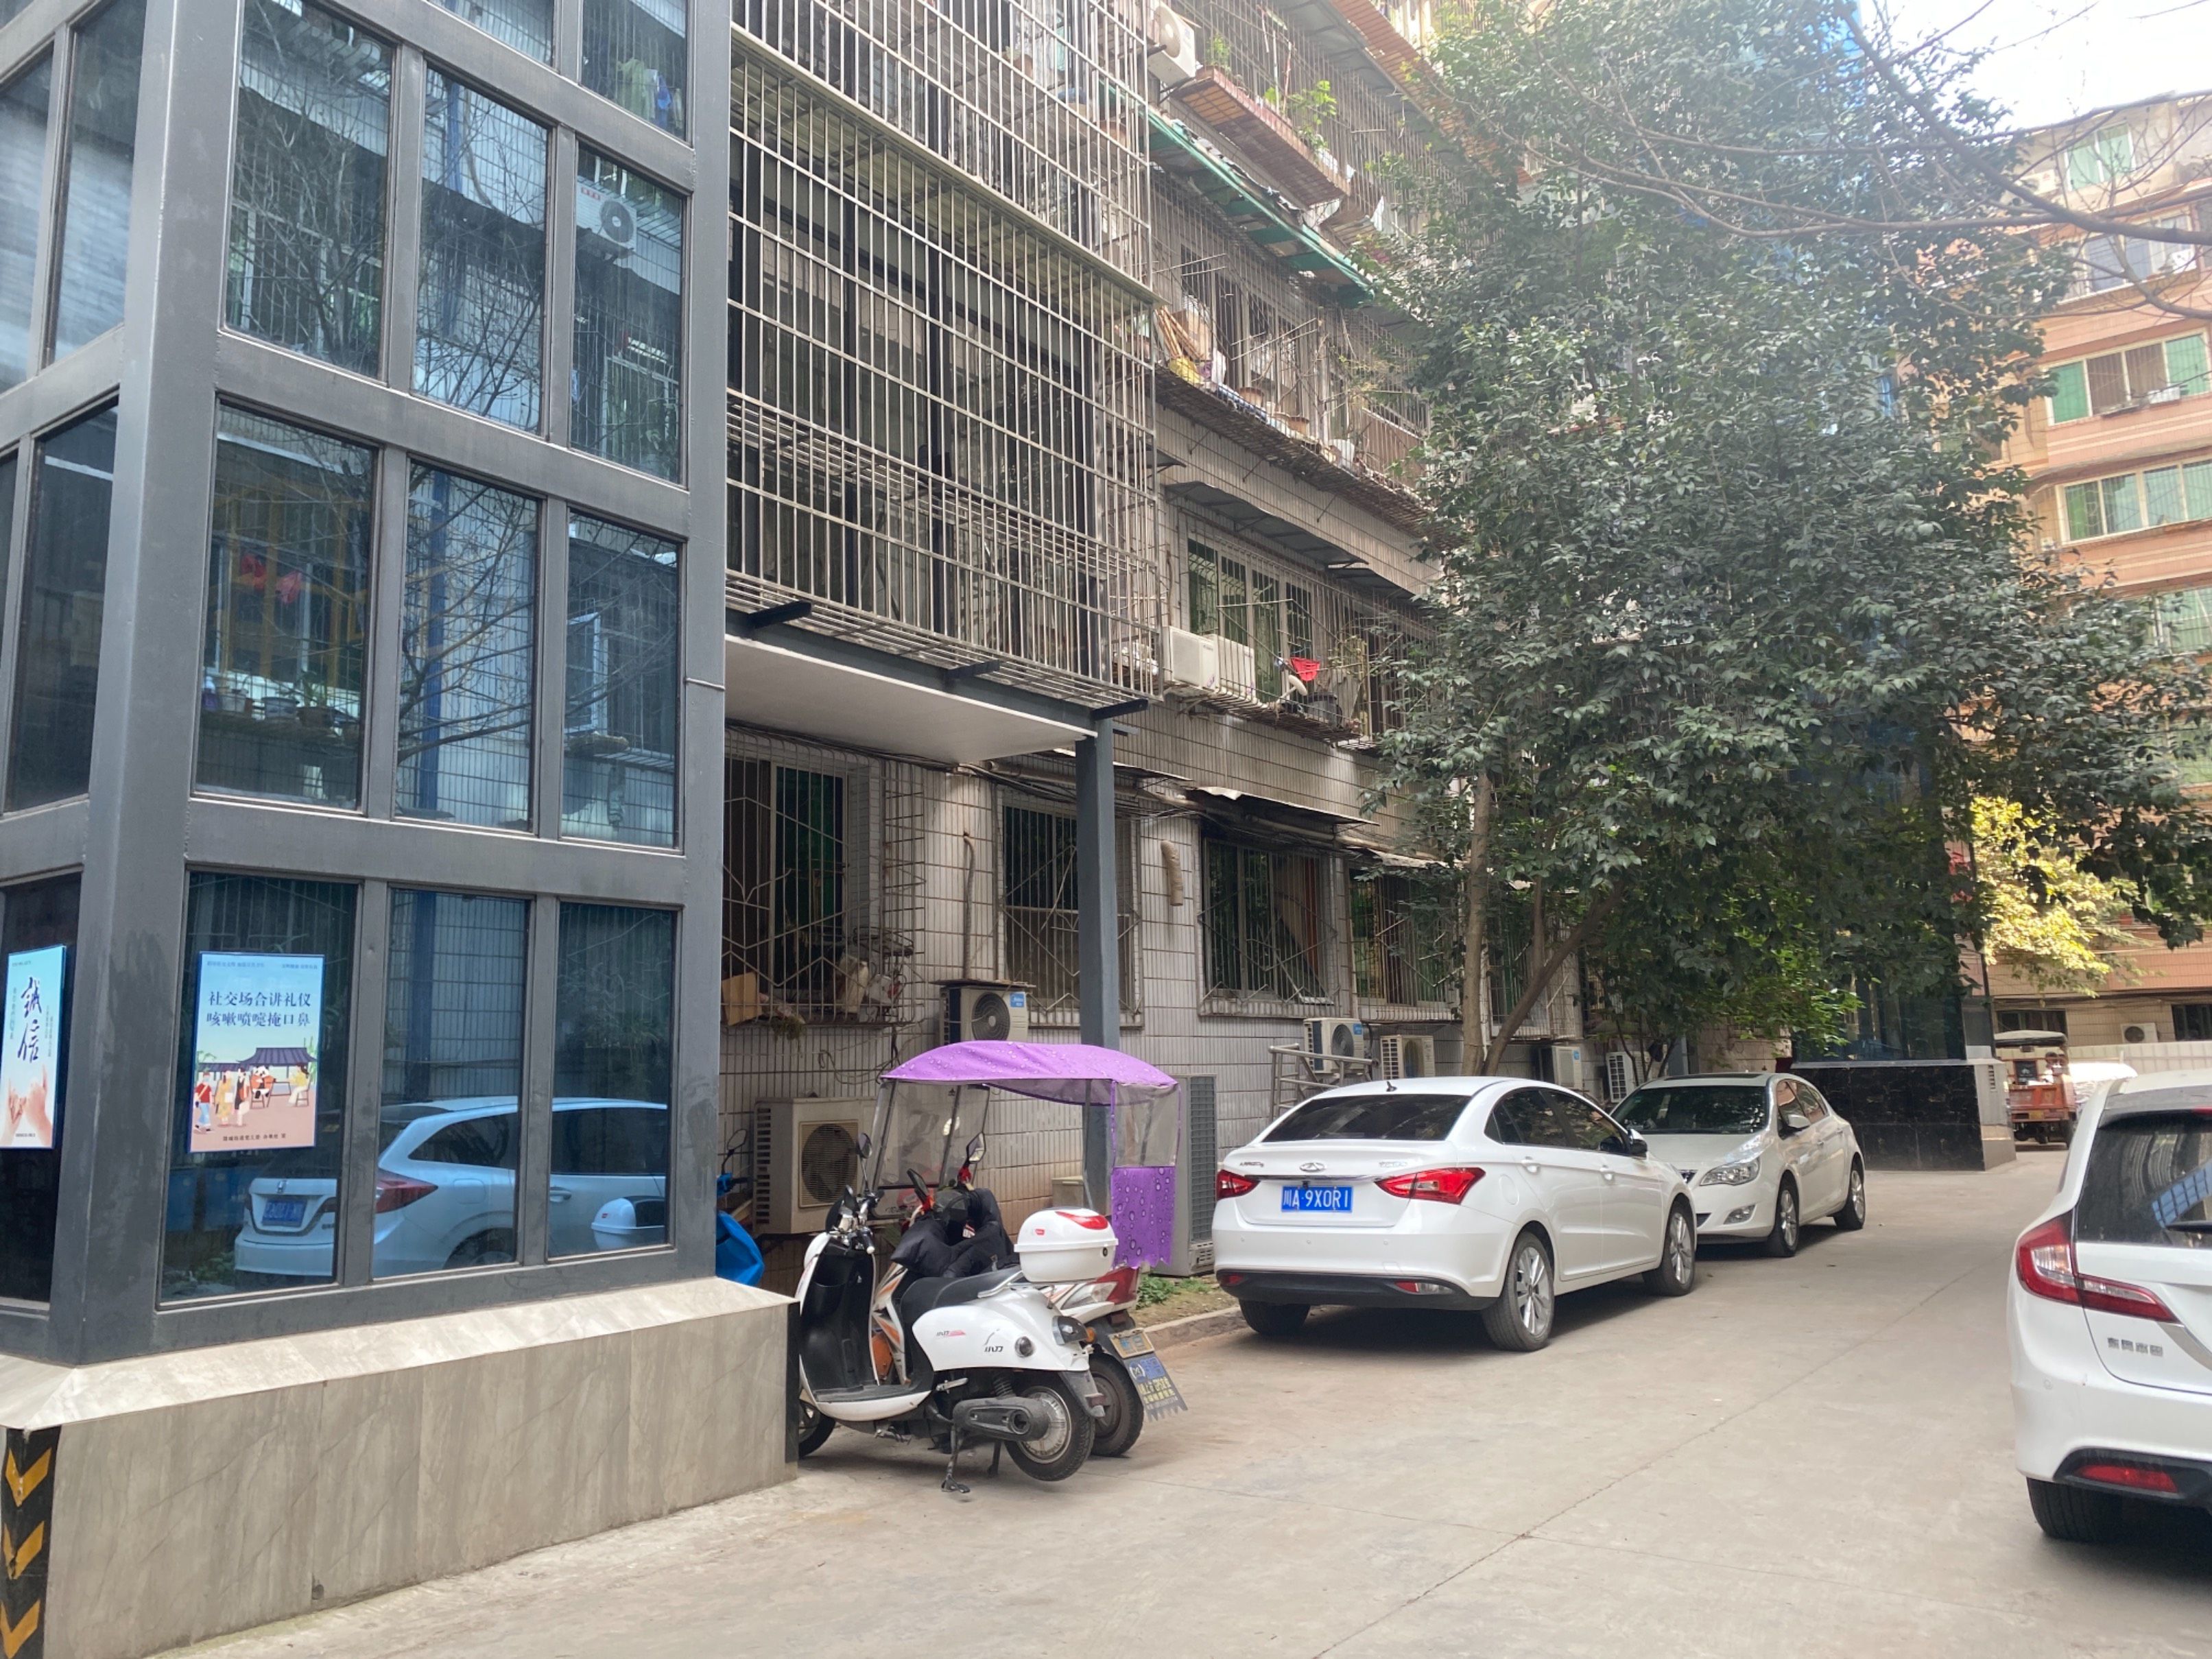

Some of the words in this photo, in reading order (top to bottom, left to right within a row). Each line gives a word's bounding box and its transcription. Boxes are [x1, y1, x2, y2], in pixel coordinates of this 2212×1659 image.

[208, 991, 311, 1007] 社交场合讲礼仪
[206, 1012, 310, 1027] 咳嗽喷嚏掩口鼻
